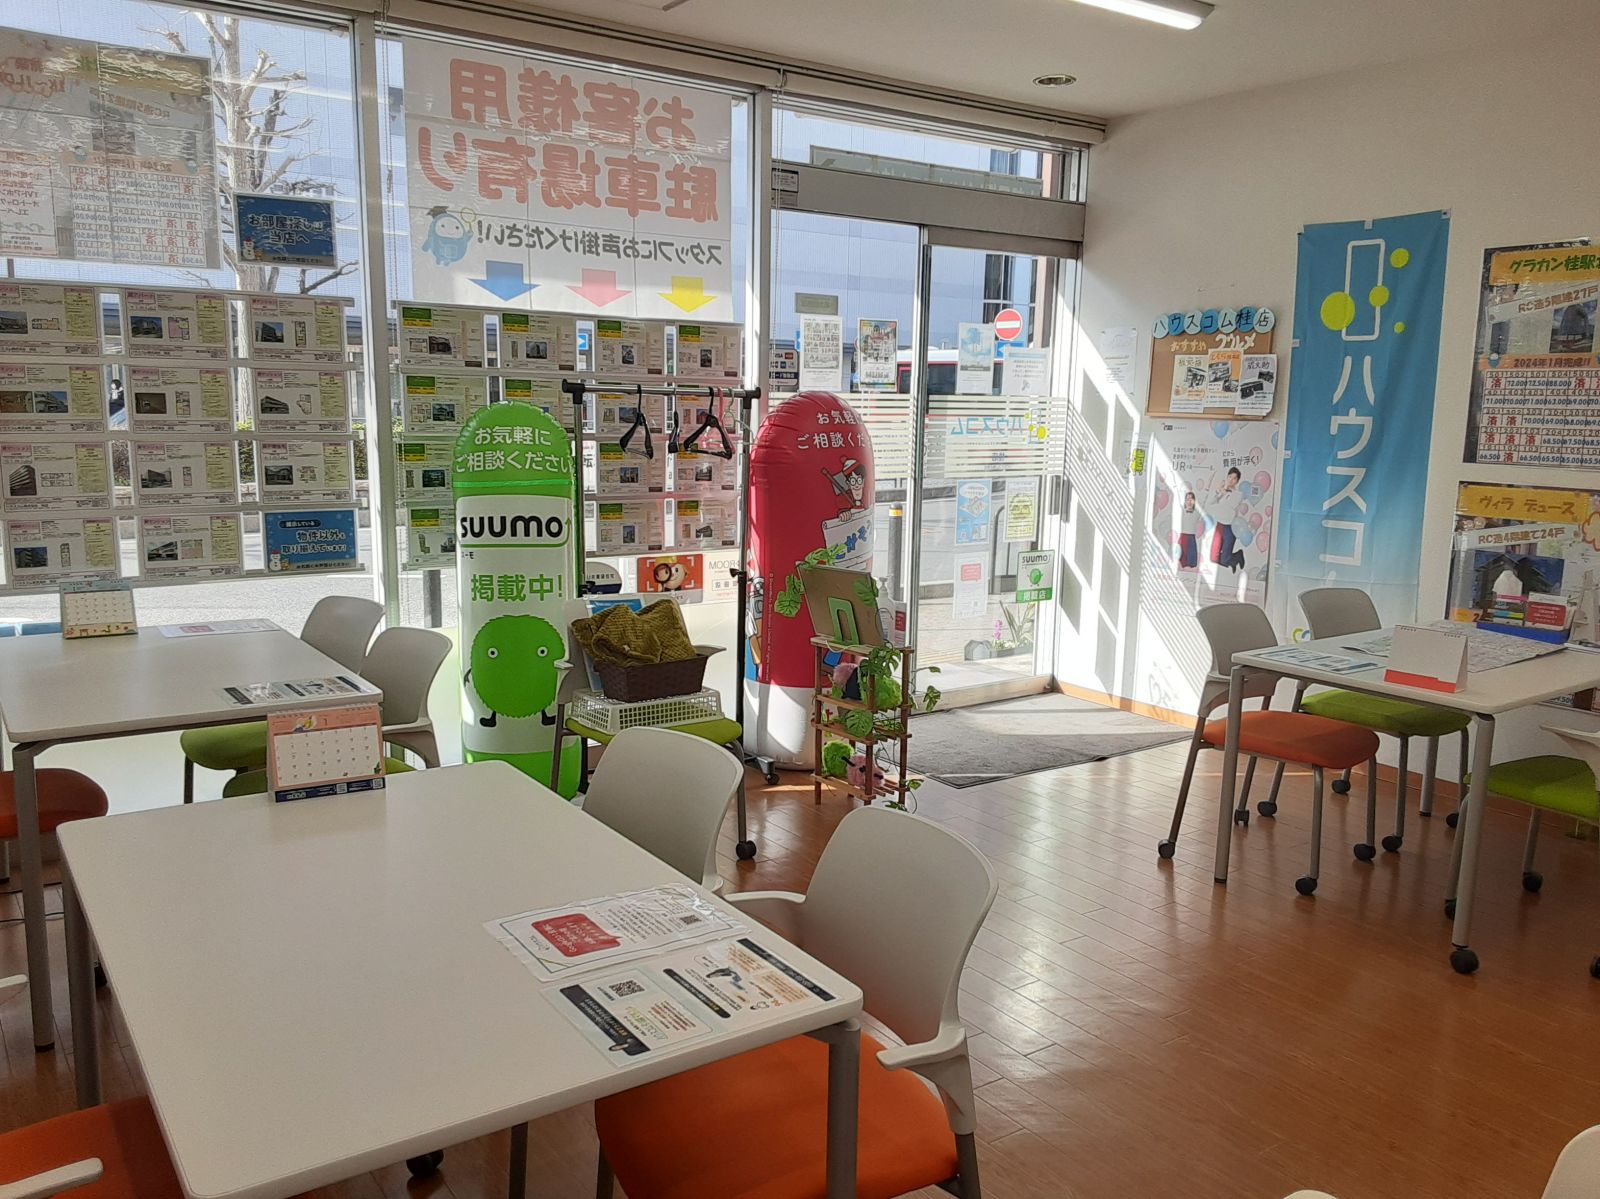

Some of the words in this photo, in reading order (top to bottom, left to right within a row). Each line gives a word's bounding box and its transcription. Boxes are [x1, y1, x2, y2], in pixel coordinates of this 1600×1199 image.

[1154, 309, 1270, 333] ハウスコム桂店
[1170, 339, 1207, 352] おすすめ
[474, 426, 552, 446] お気軽に
[454, 452, 570, 473] ご相談ください
[1319, 355, 1375, 586] ハウスコ
[471, 574, 563, 602] 掲載中!
